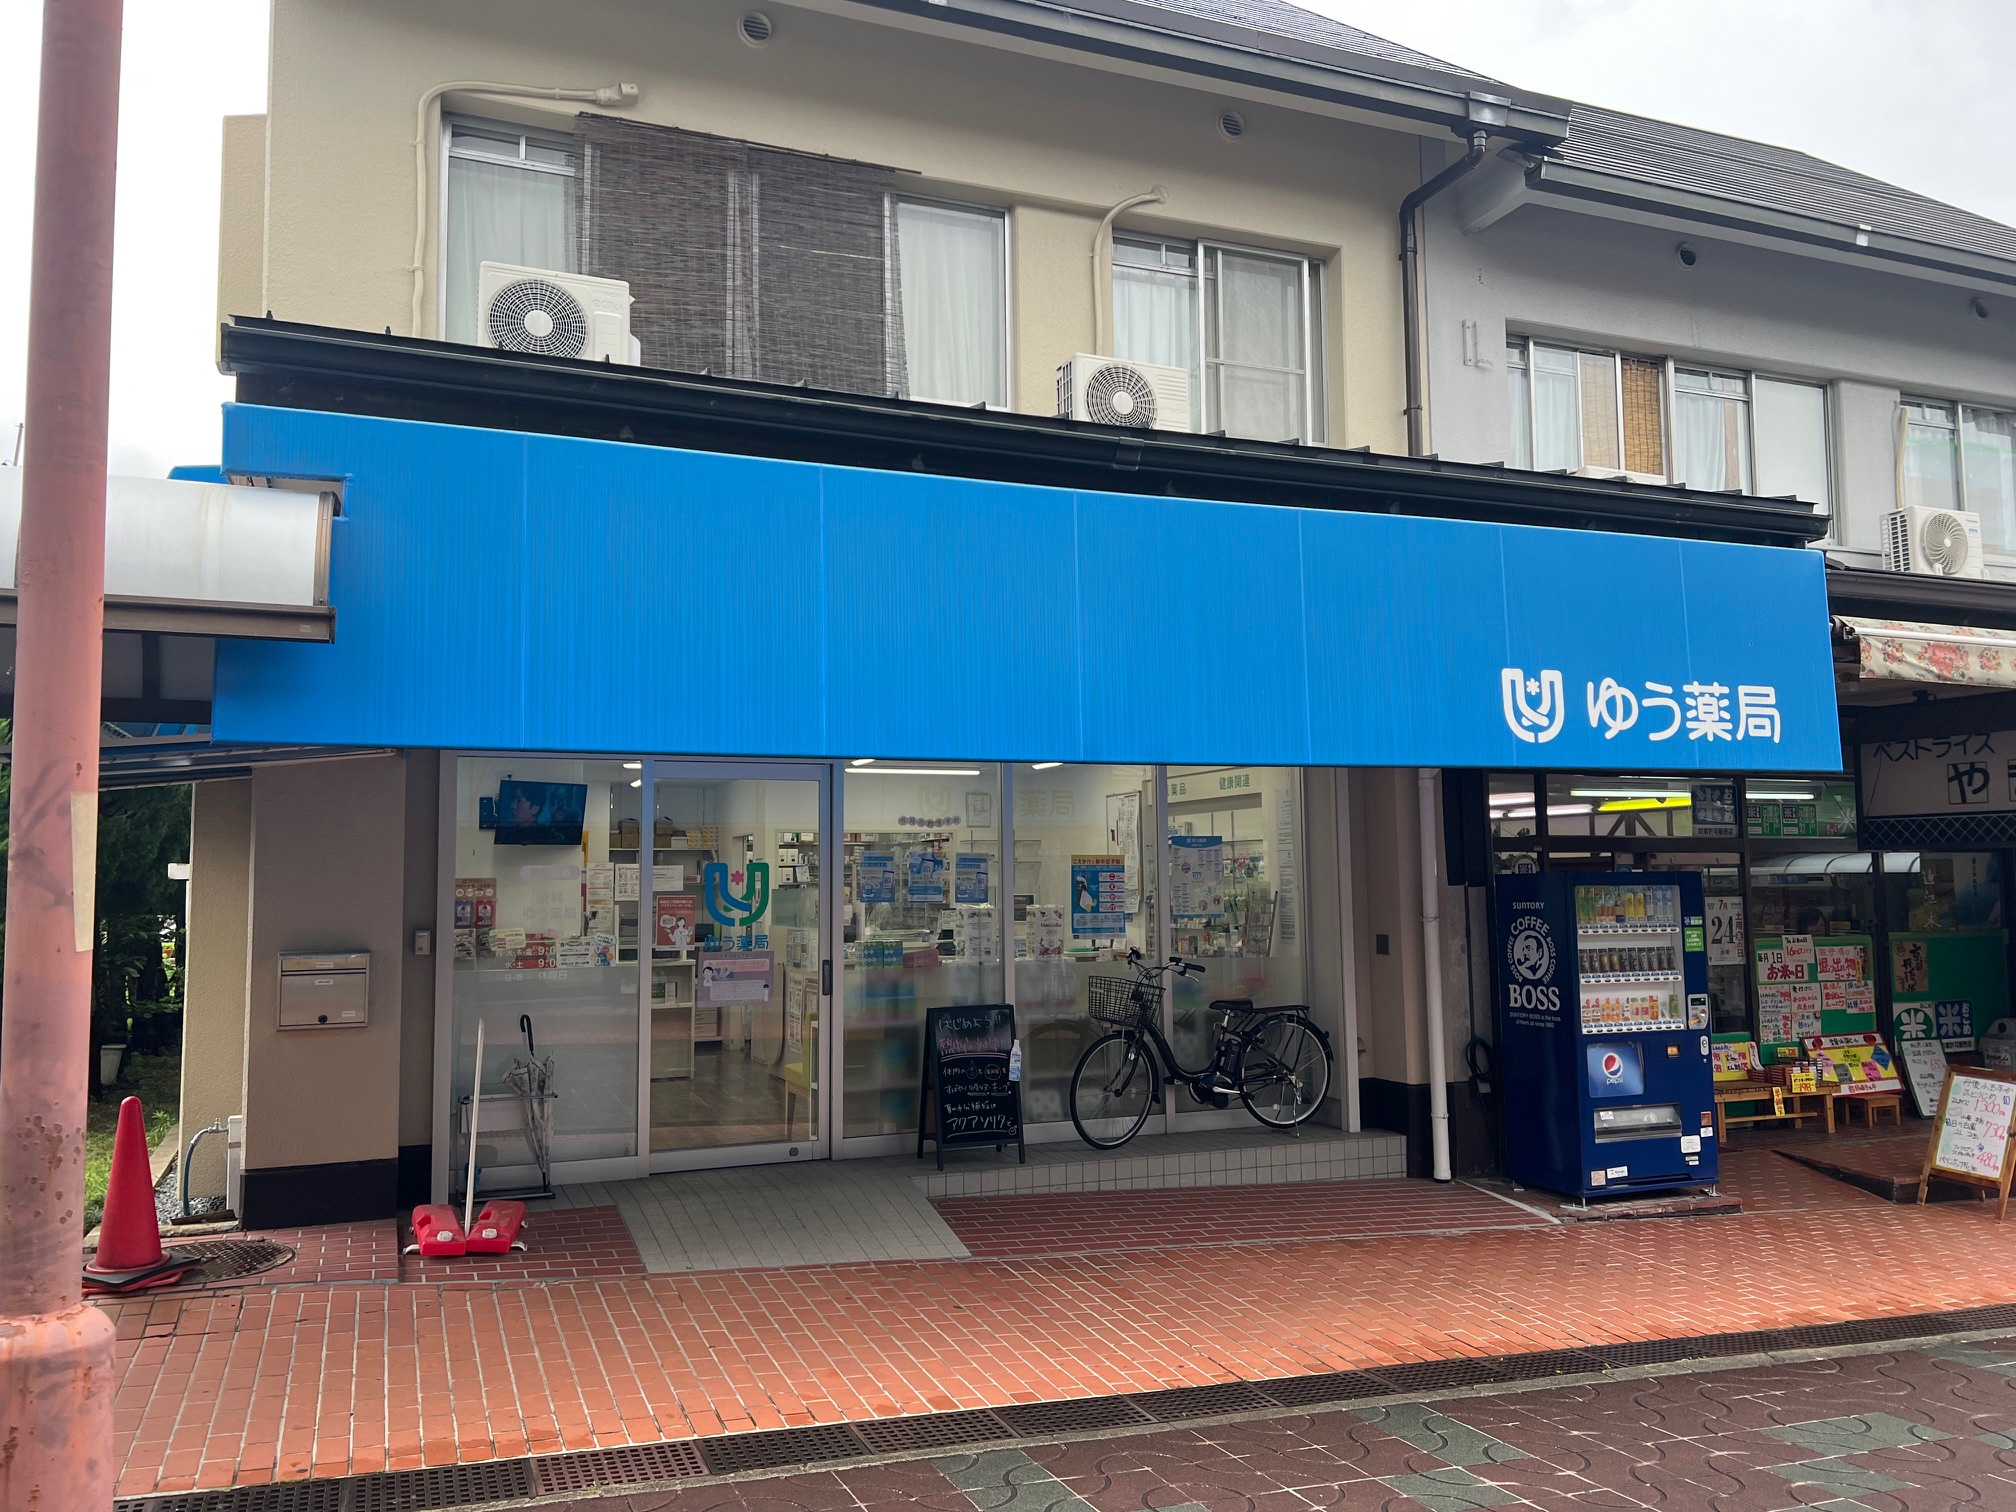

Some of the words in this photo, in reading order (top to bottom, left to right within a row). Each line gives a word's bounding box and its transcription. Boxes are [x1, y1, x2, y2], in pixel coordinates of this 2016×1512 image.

[1586, 677, 1781, 743] ゆう薬局
[1874, 733, 1995, 762] ベストライス
[1219, 774, 1250, 791] 健康関連
[523, 907, 576, 920] ゆう薬局
[1512, 901, 1545, 910] SUNTORY
[1510, 915, 1550, 937] COFFEE
[1711, 915, 1736, 945] 24
[704, 934, 769, 952] ゆう薬局
[1508, 984, 1561, 1012] BOSS
[1606, 1077, 1624, 1085] pepsi
